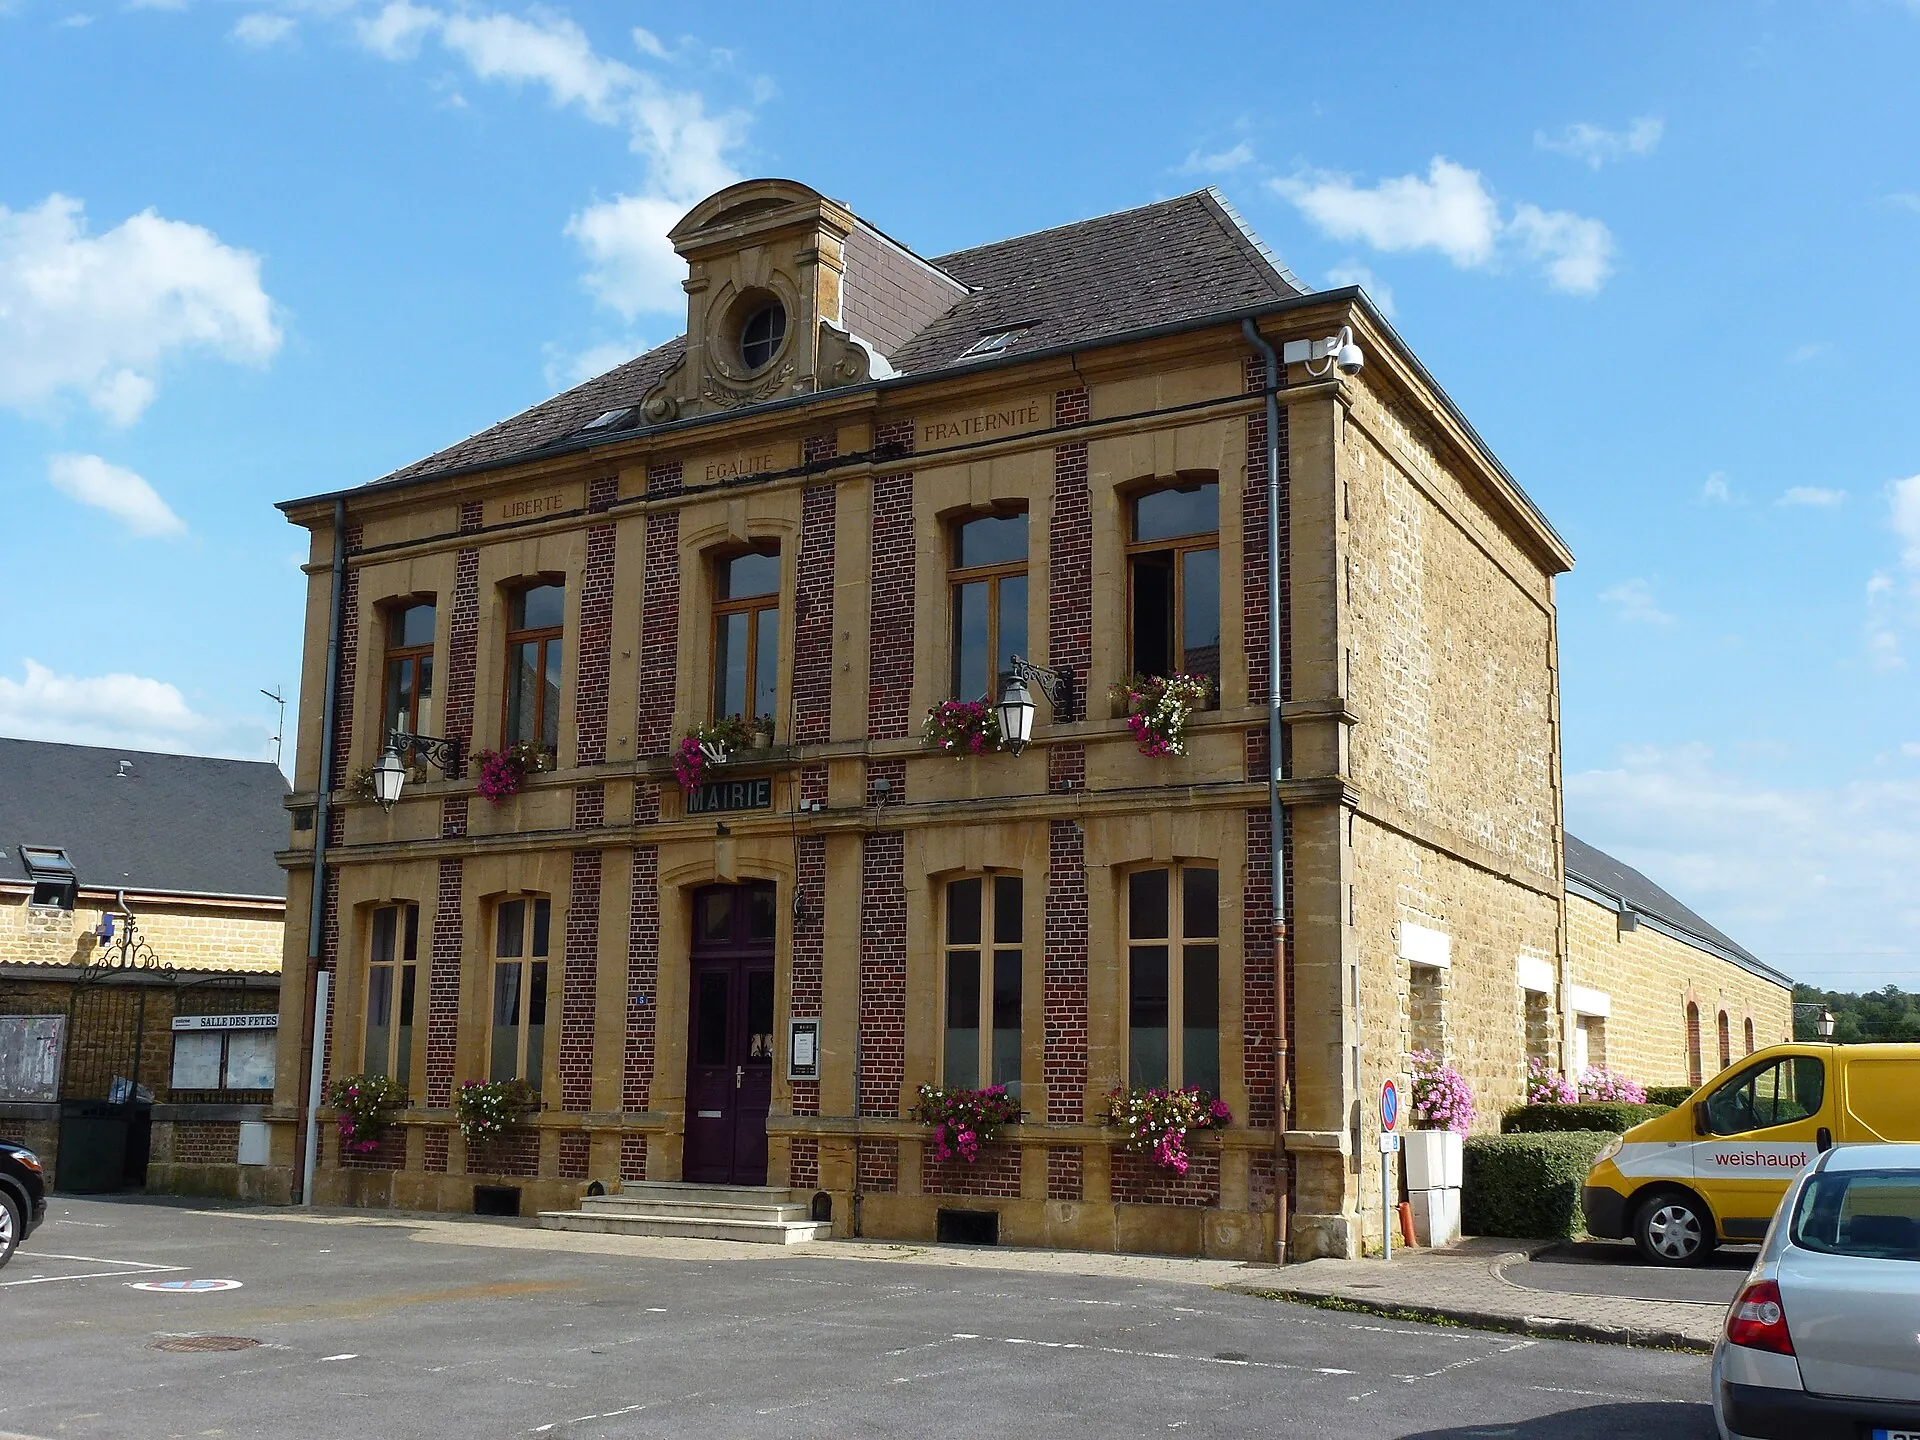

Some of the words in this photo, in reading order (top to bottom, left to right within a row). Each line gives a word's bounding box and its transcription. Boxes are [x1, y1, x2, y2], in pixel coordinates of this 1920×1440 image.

[925, 401, 1040, 442] FRATERNITÉ
[705, 449, 773, 481] ÉGALITÉ
[502, 490, 564, 518] LIBERTÉ
[689, 780, 769, 812] MAIRIE
[200, 1017, 228, 1027] SALLE
[229, 1016, 247, 1027] DES
[248, 1015, 277, 1026] FETES
